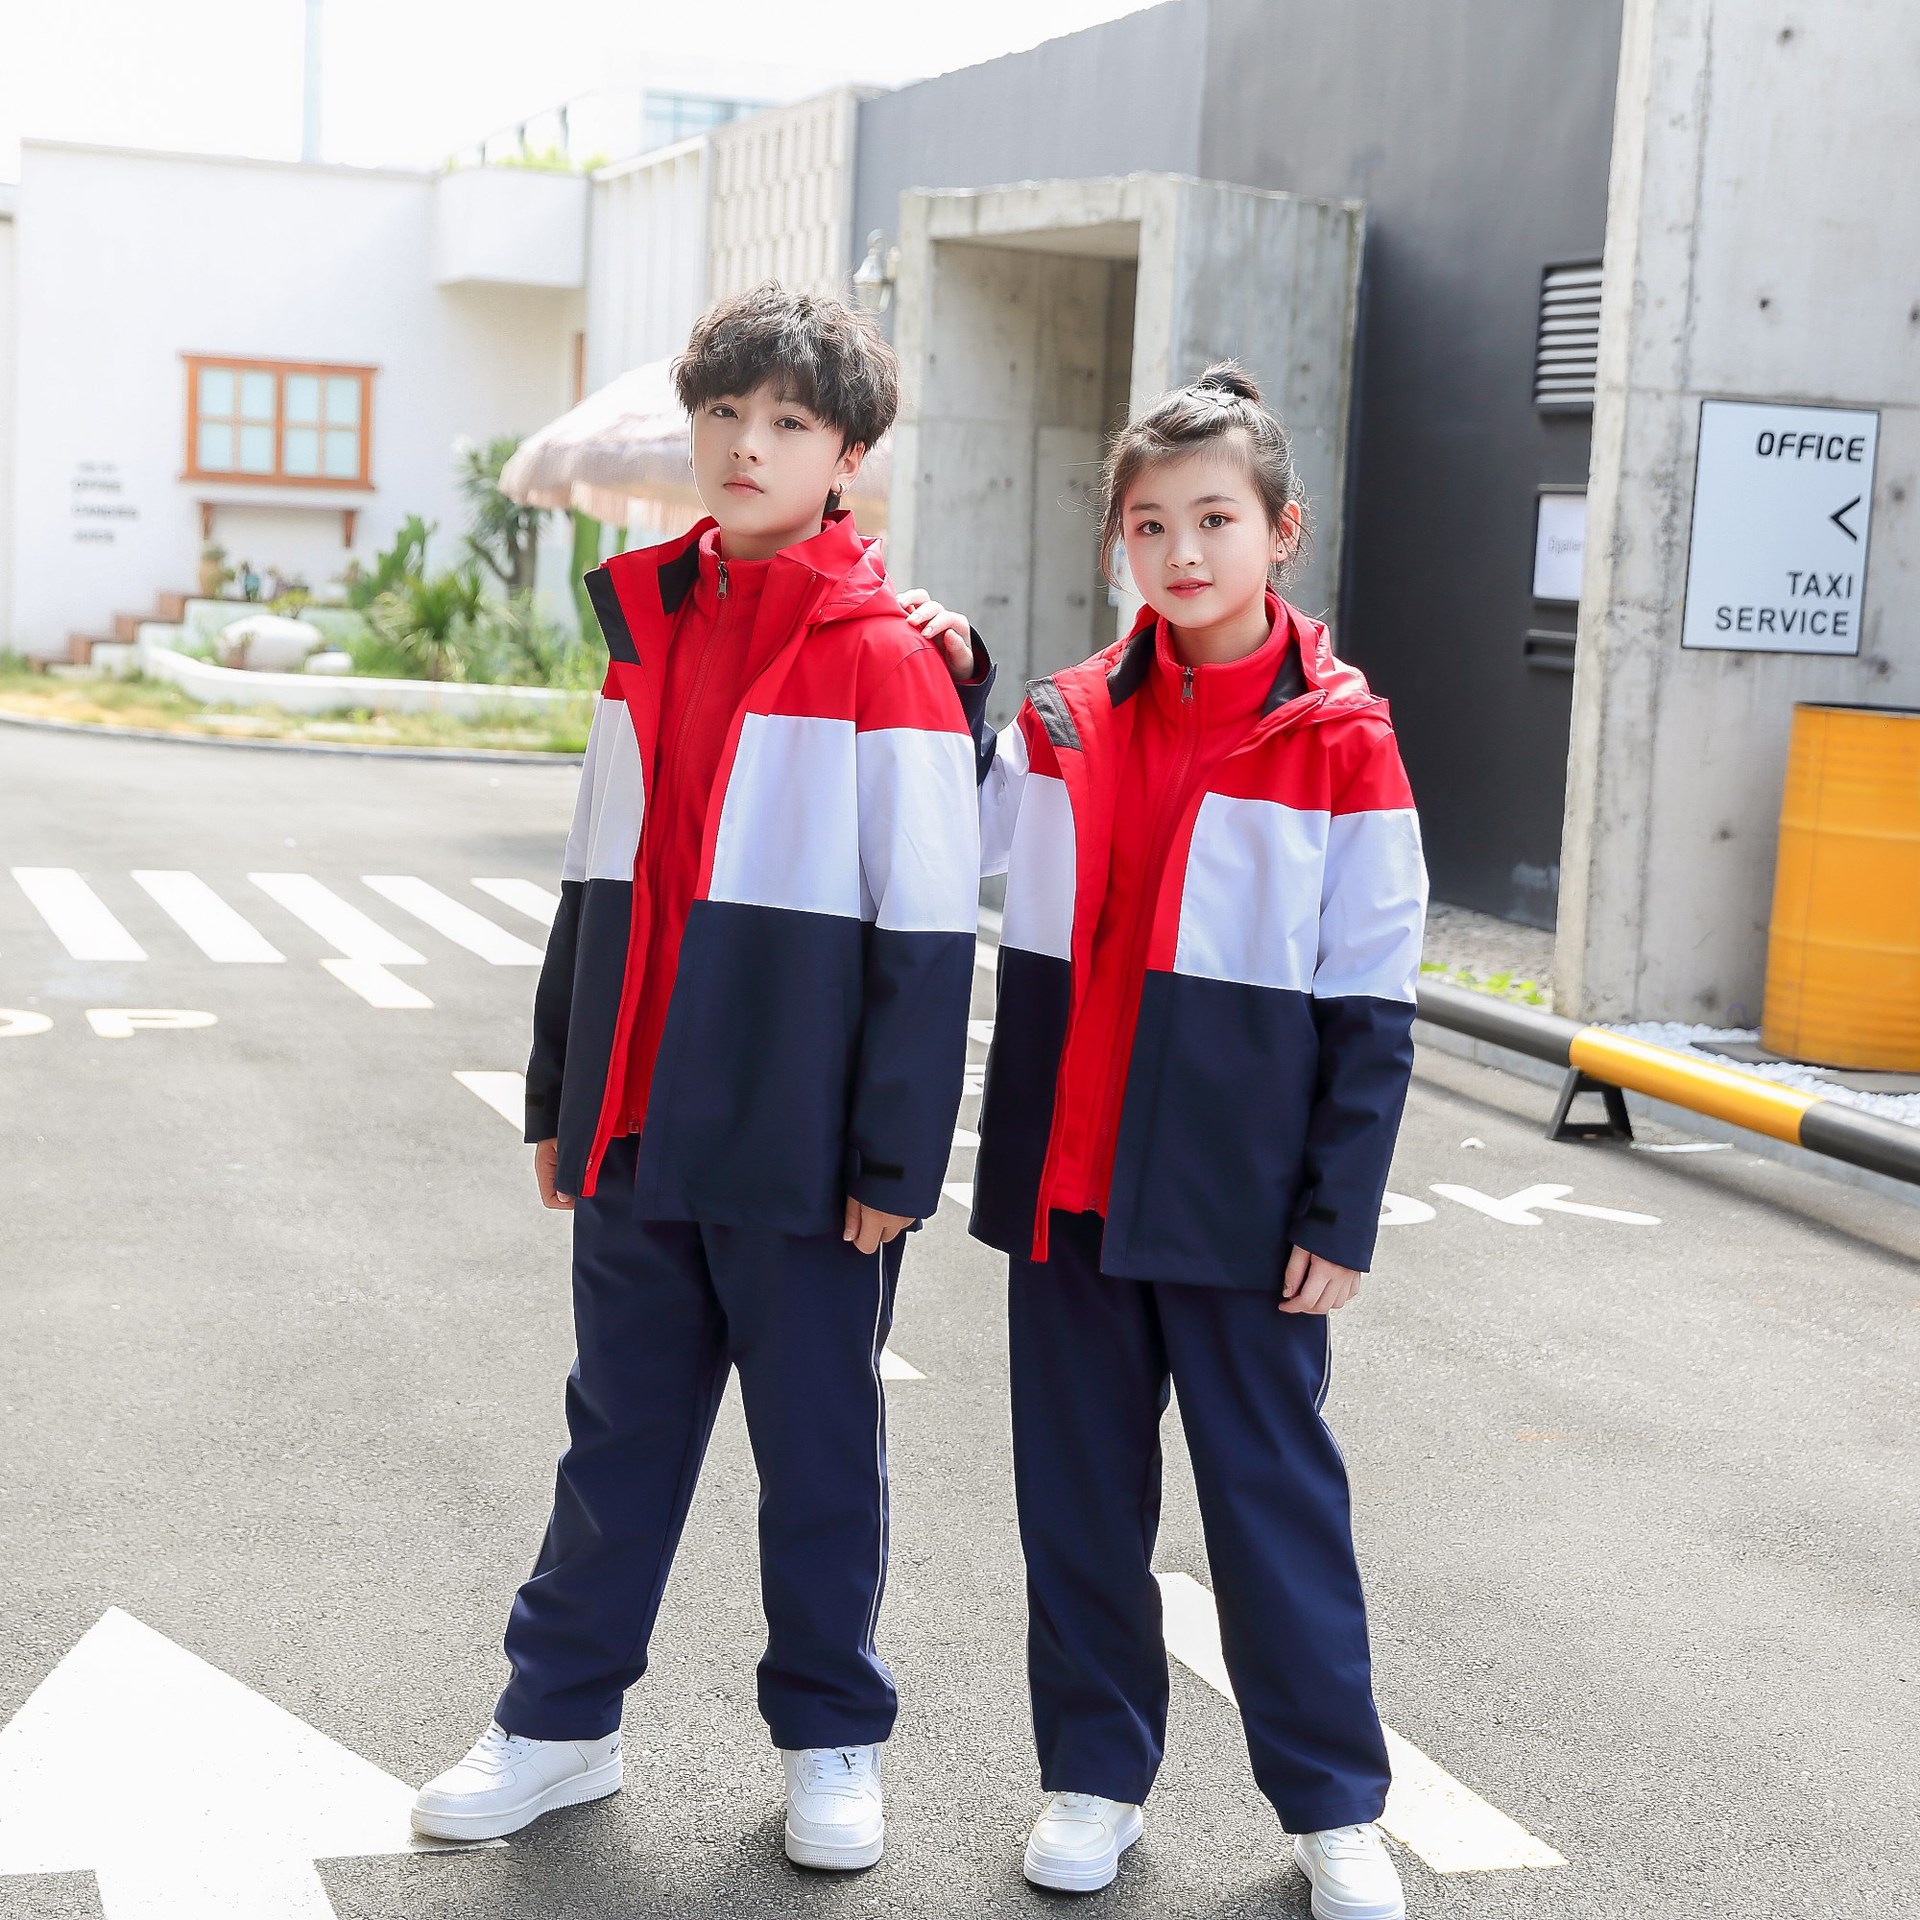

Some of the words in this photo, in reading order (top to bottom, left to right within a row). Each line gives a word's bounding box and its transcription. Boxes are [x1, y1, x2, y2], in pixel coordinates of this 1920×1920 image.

[1757, 432, 1866, 463] OFFICE
[1789, 572, 1853, 599] TAXI
[1717, 607, 1850, 637] SERVICE
